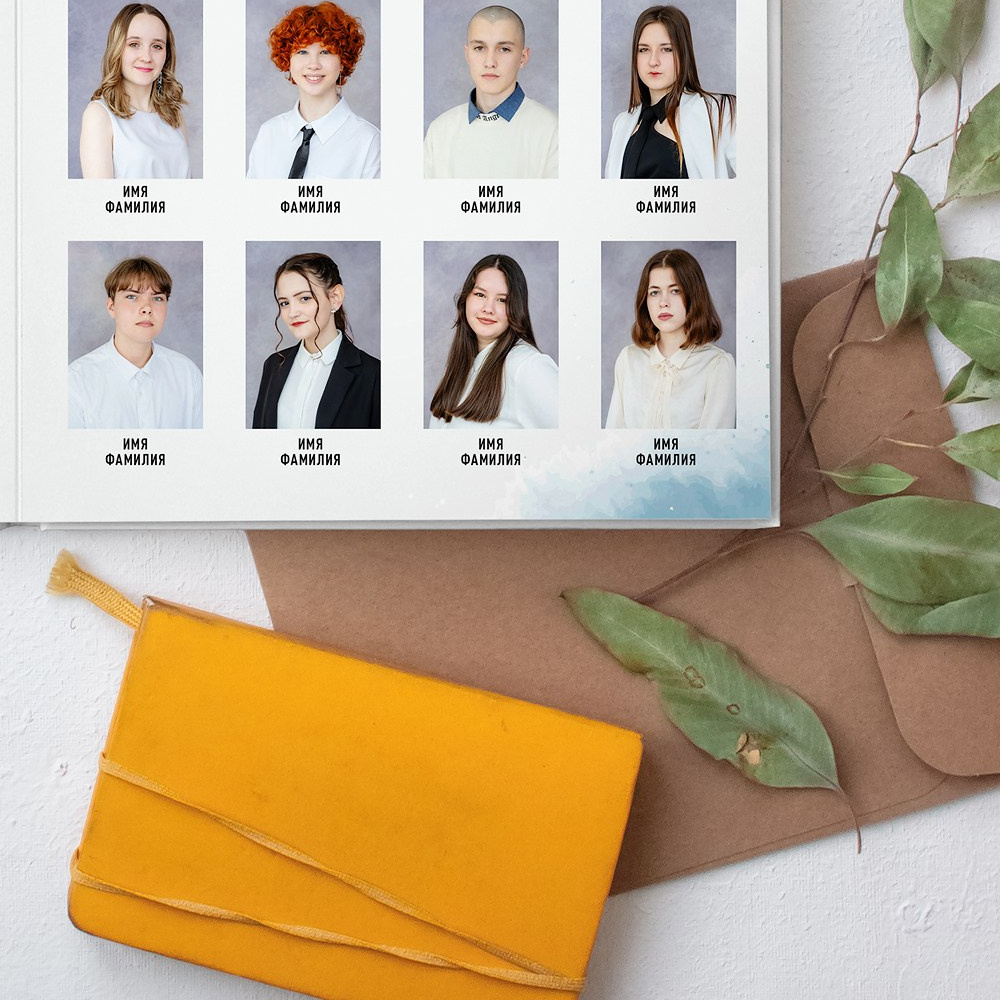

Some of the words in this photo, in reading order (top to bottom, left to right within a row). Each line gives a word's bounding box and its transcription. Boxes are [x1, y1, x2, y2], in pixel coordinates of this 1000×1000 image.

[123, 185, 148, 198] ИМЯ
[298, 185, 323, 198] ИМЯ
[478, 185, 504, 198] ИМЯ
[653, 185, 679, 198] ИМЯ
[105, 200, 166, 214] ФАМИЛИЯ
[280, 200, 341, 214] ФАМИЛИЯ
[460, 200, 521, 214] ФАМИЛИЯ
[635, 200, 696, 214] ФАМИЛИЯ
[123, 437, 148, 451] ИМЯ
[298, 437, 323, 451] ИМЯ
[478, 437, 504, 451] ИМЯ
[653, 437, 679, 451] ИМЯ
[105, 453, 166, 466] ФАМИЛИЯ
[280, 452, 341, 466] ФАМИЛИЯ
[460, 452, 521, 466] ФАМИЛИЯ
[635, 452, 696, 466] ФАМИЛИЯ
